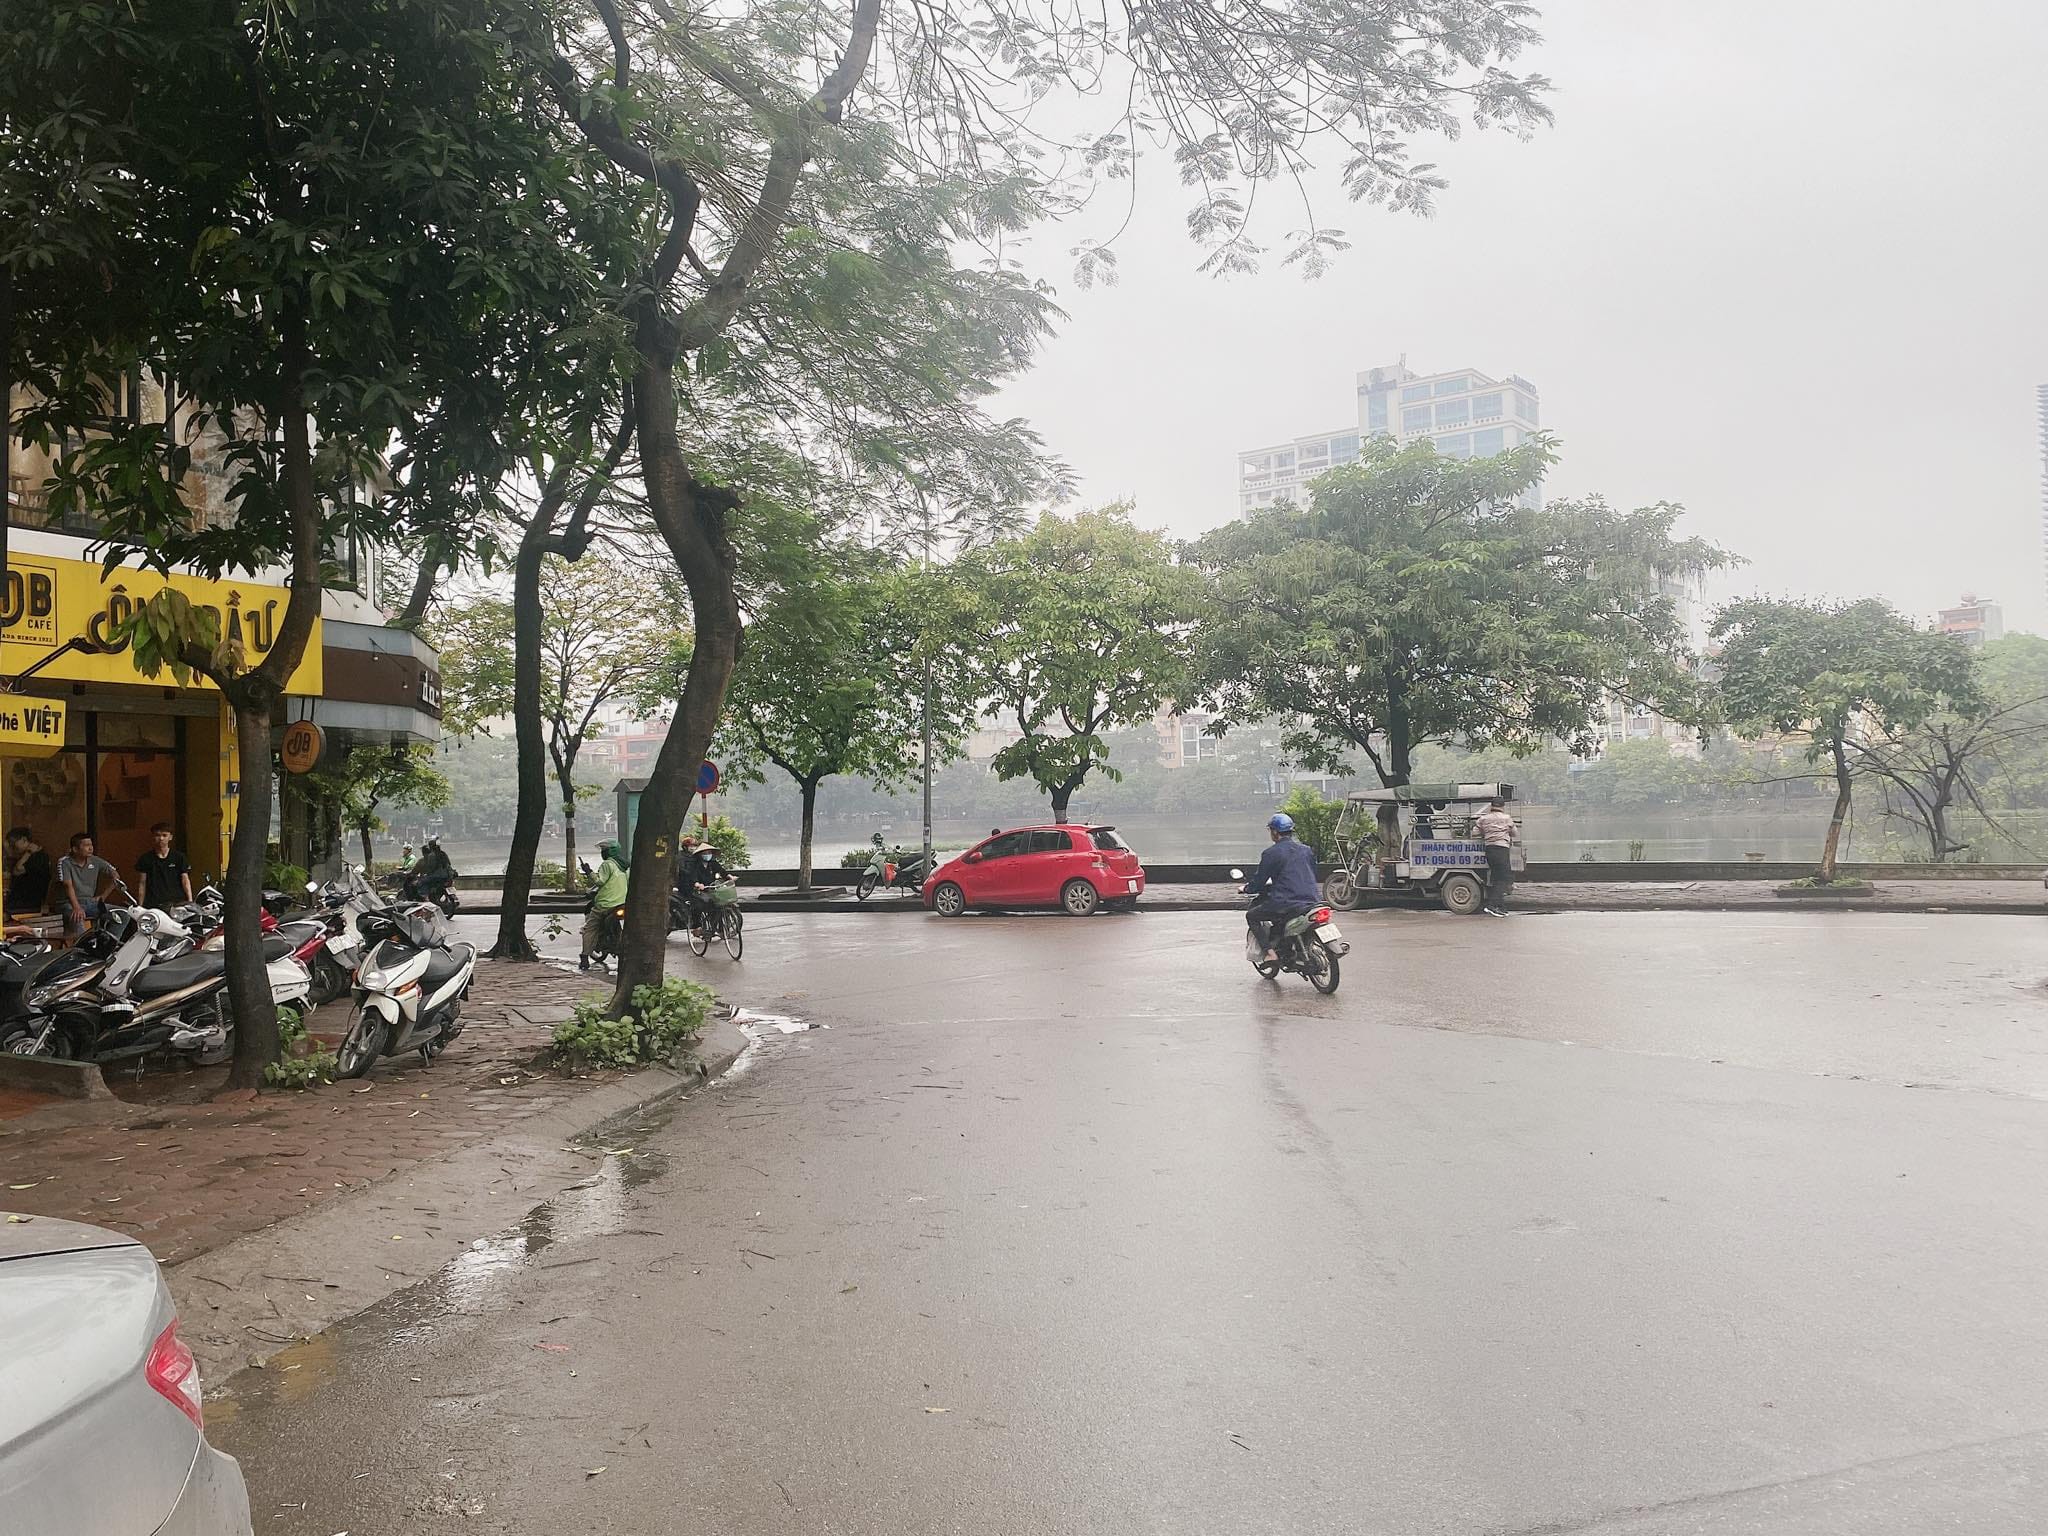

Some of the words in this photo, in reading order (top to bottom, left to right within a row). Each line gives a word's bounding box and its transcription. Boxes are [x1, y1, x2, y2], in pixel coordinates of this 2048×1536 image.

[28, 617, 51, 630] CAFÉ
[0, 712, 18, 730] hê
[24, 704, 62, 739] VIỆT
[1432, 856, 1456, 865] 0948
